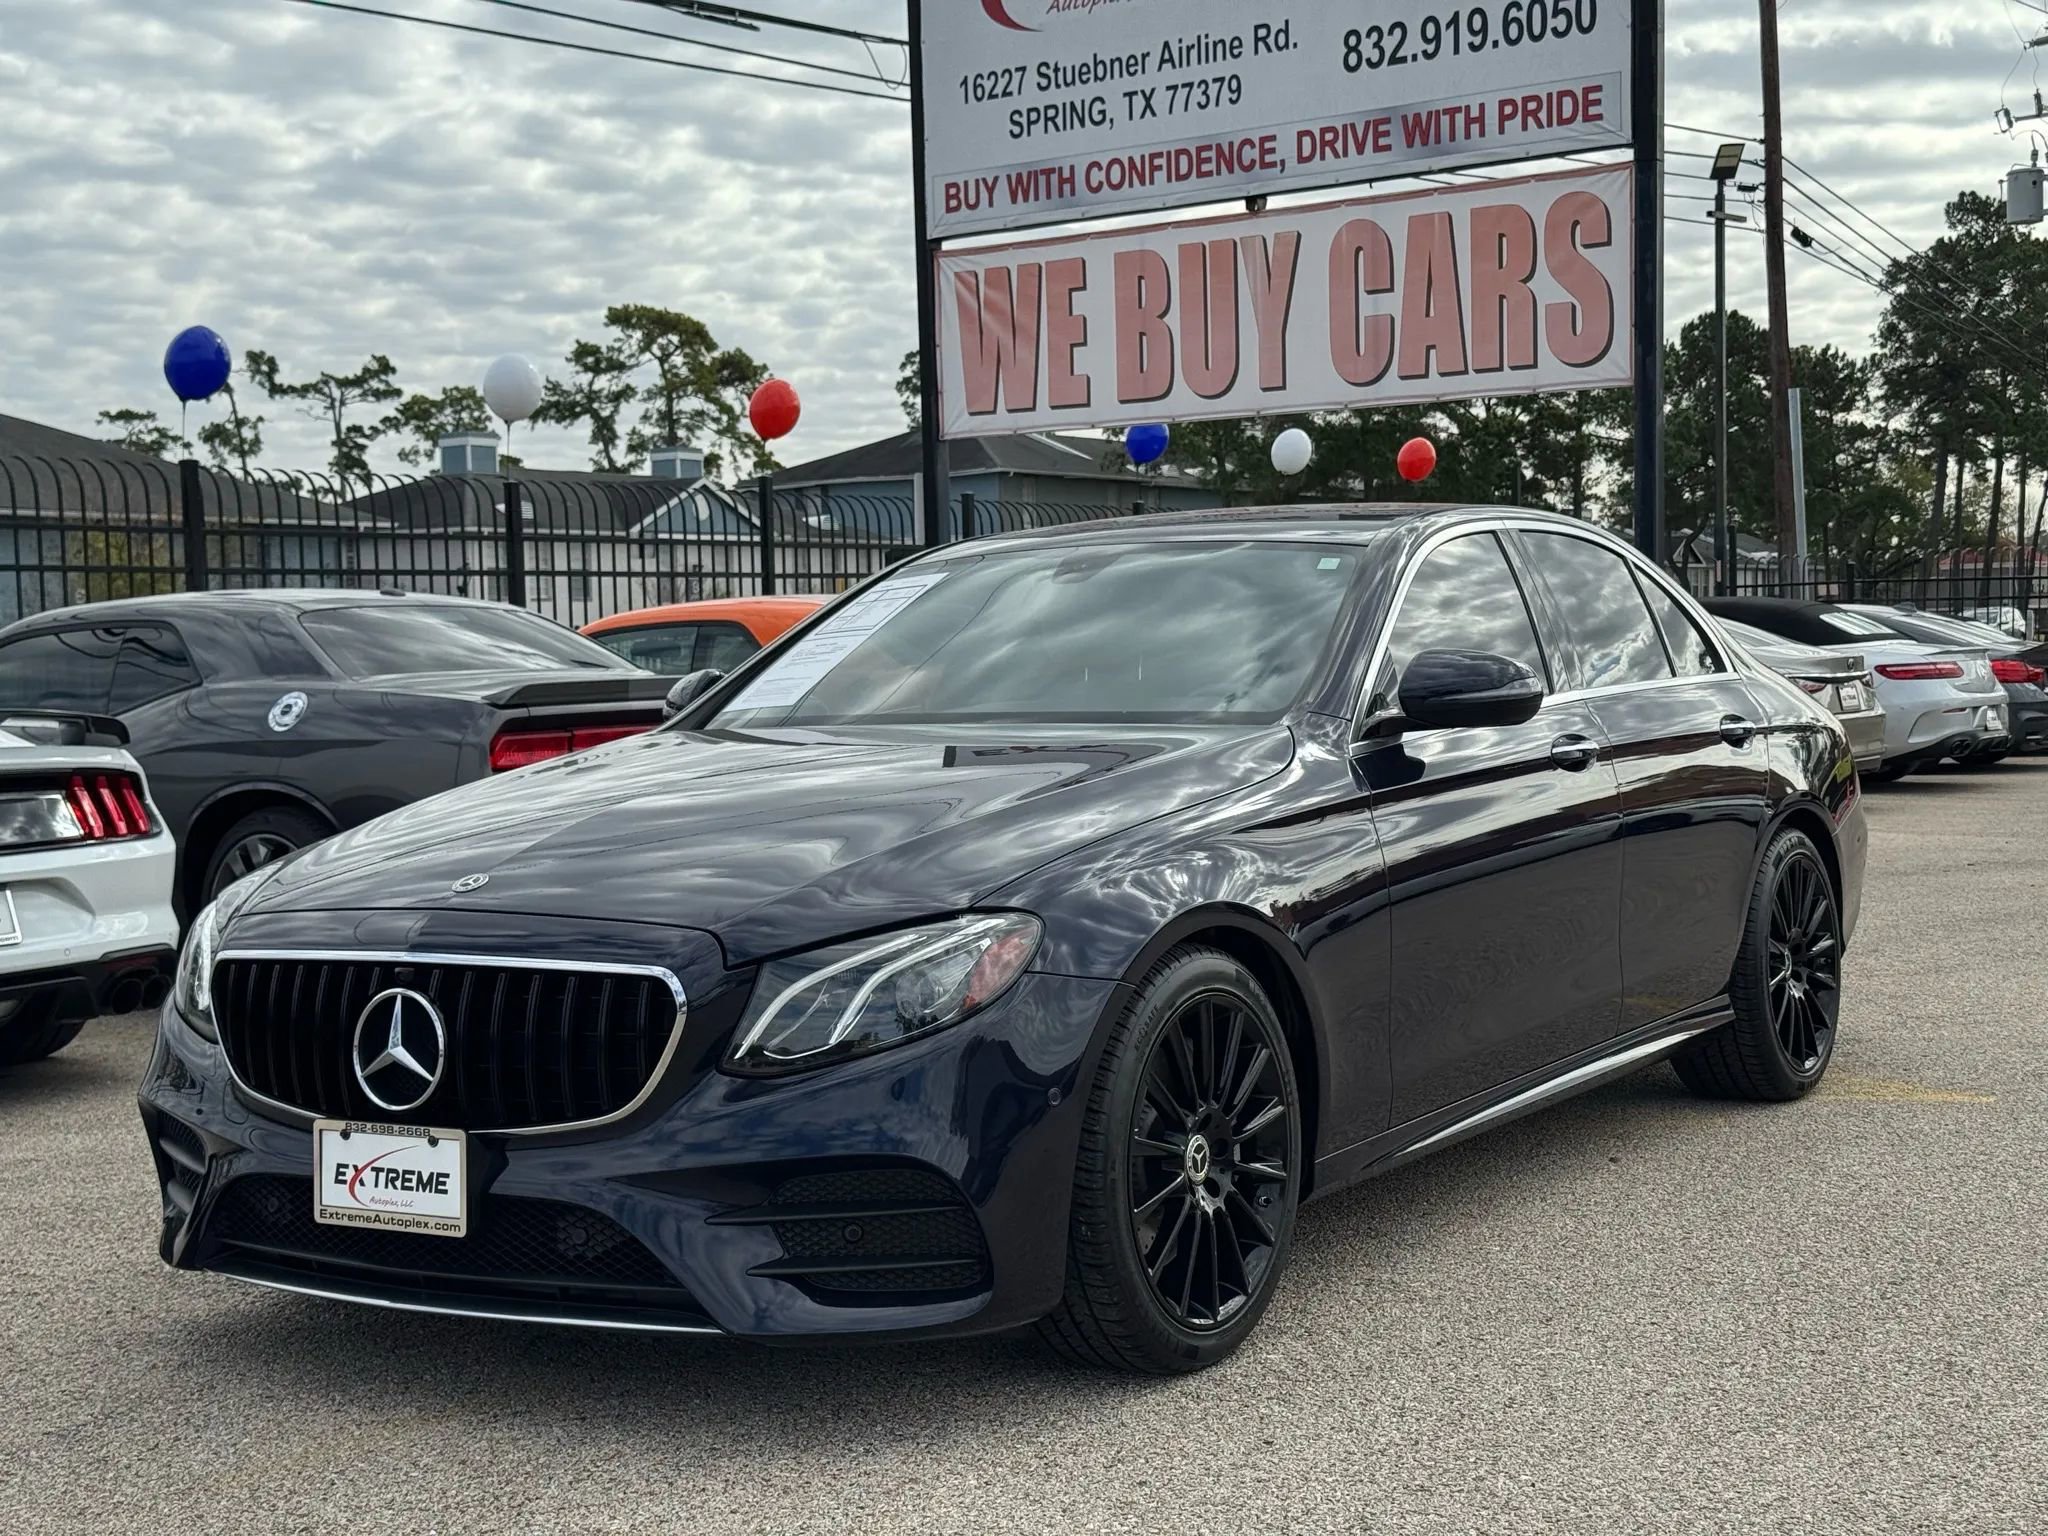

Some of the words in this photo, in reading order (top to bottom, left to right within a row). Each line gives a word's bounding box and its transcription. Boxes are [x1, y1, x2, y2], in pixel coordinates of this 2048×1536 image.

[959, 66, 1027, 105] 16227
[1036, 50, 1151, 92] Stuebner
[1157, 33, 1243, 72] Airline
[1252, 19, 1298, 56] Rd.
[1342, 0, 1598, 74] 832.919.6050
[1008, 96, 1115, 140] SPRING,
[1122, 87, 1157, 122] TX
[1165, 74, 1242, 115] 77379
[944, 175, 1000, 214] BUY
[1006, 164, 1076, 205] WITH
[1084, 134, 1287, 195] CONFIDENCE,
[1296, 116, 1392, 165] DRIVE
[1401, 102, 1486, 149] WITH
[1498, 84, 1604, 136] PRIDE
[953, 256, 1091, 415] WE
[1113, 230, 1302, 403] BUY
[1328, 190, 1613, 387] CARS
[334, 1162, 450, 1195] EXTREME
[368, 1195, 398, 1207] Autoplex,
[400, 1198, 414, 1208] LLC
[319, 1208, 461, 1233] ExtremeAutoplex.com
